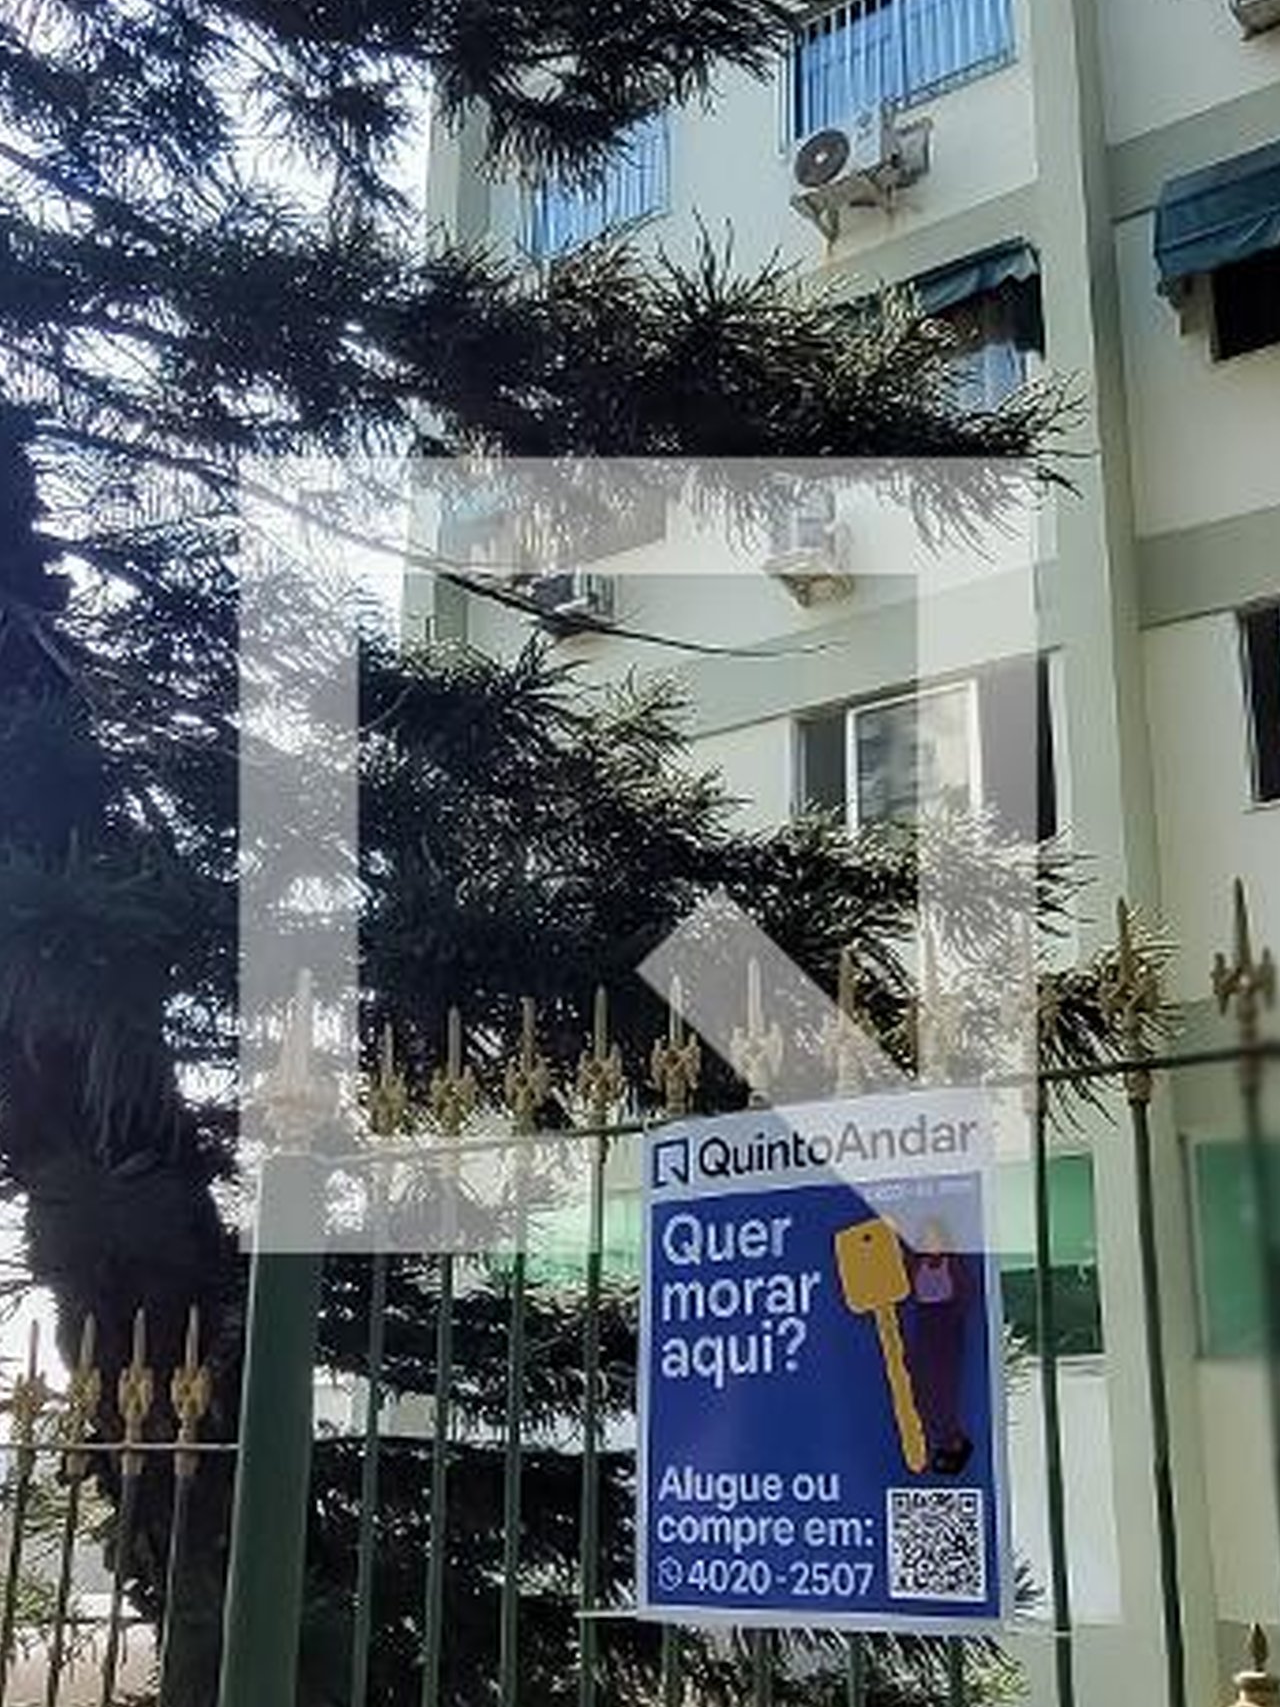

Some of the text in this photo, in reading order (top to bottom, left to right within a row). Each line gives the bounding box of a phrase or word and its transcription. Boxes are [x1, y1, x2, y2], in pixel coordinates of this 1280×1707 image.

[698, 1115, 978, 1177] QuintoAndar
[662, 1213, 793, 1265] Quer
[660, 1273, 821, 1321] morar
[660, 1320, 807, 1387] aqui?
[658, 1466, 839, 1511] Alugue ou
[657, 1513, 875, 1553] compre em:
